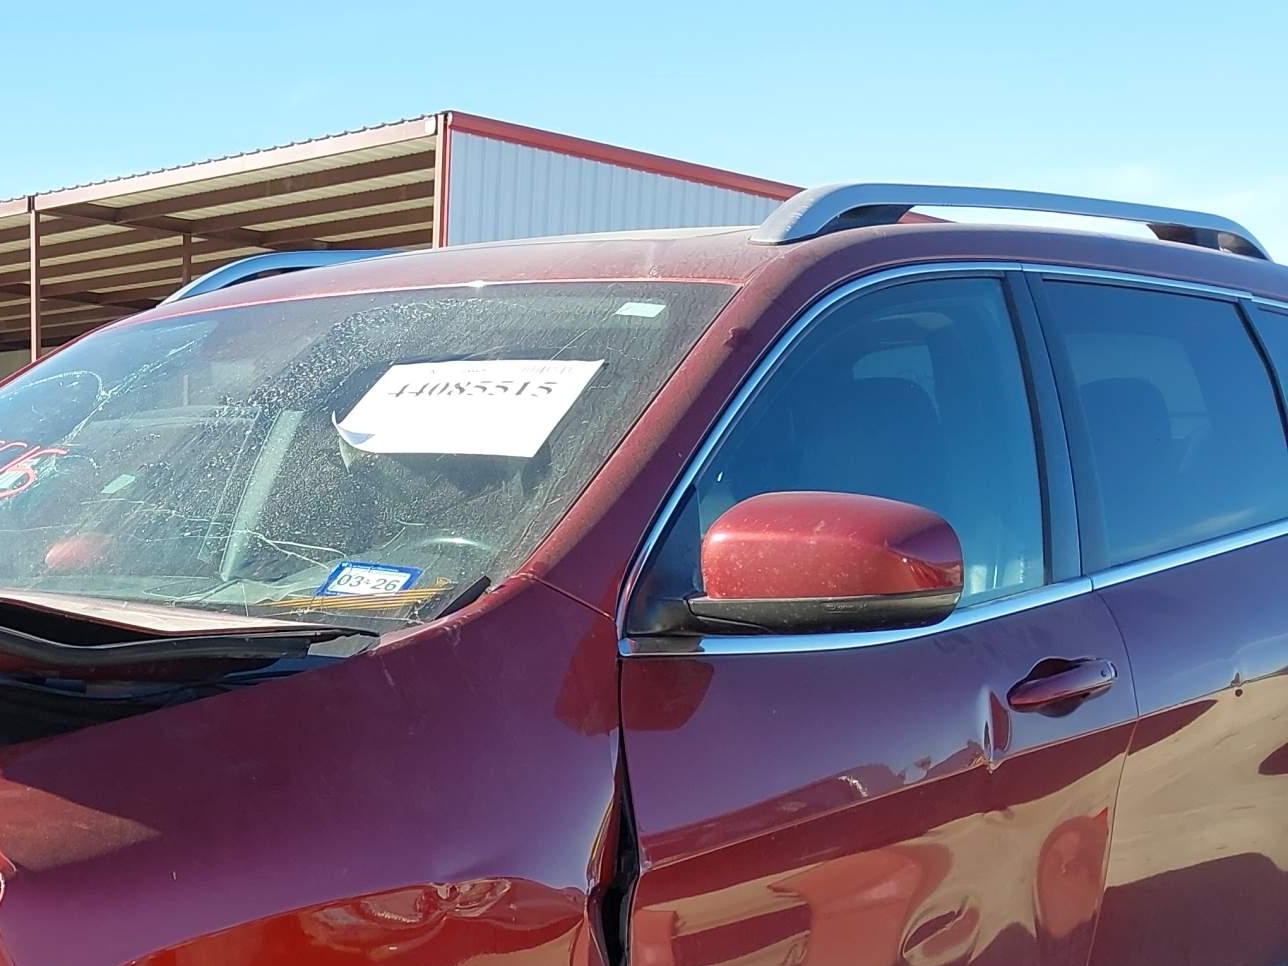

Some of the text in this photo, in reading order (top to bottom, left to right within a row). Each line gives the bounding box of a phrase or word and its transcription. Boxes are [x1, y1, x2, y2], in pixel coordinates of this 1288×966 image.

[388, 380, 558, 398] 44085515
[336, 574, 401, 592] 03 26
